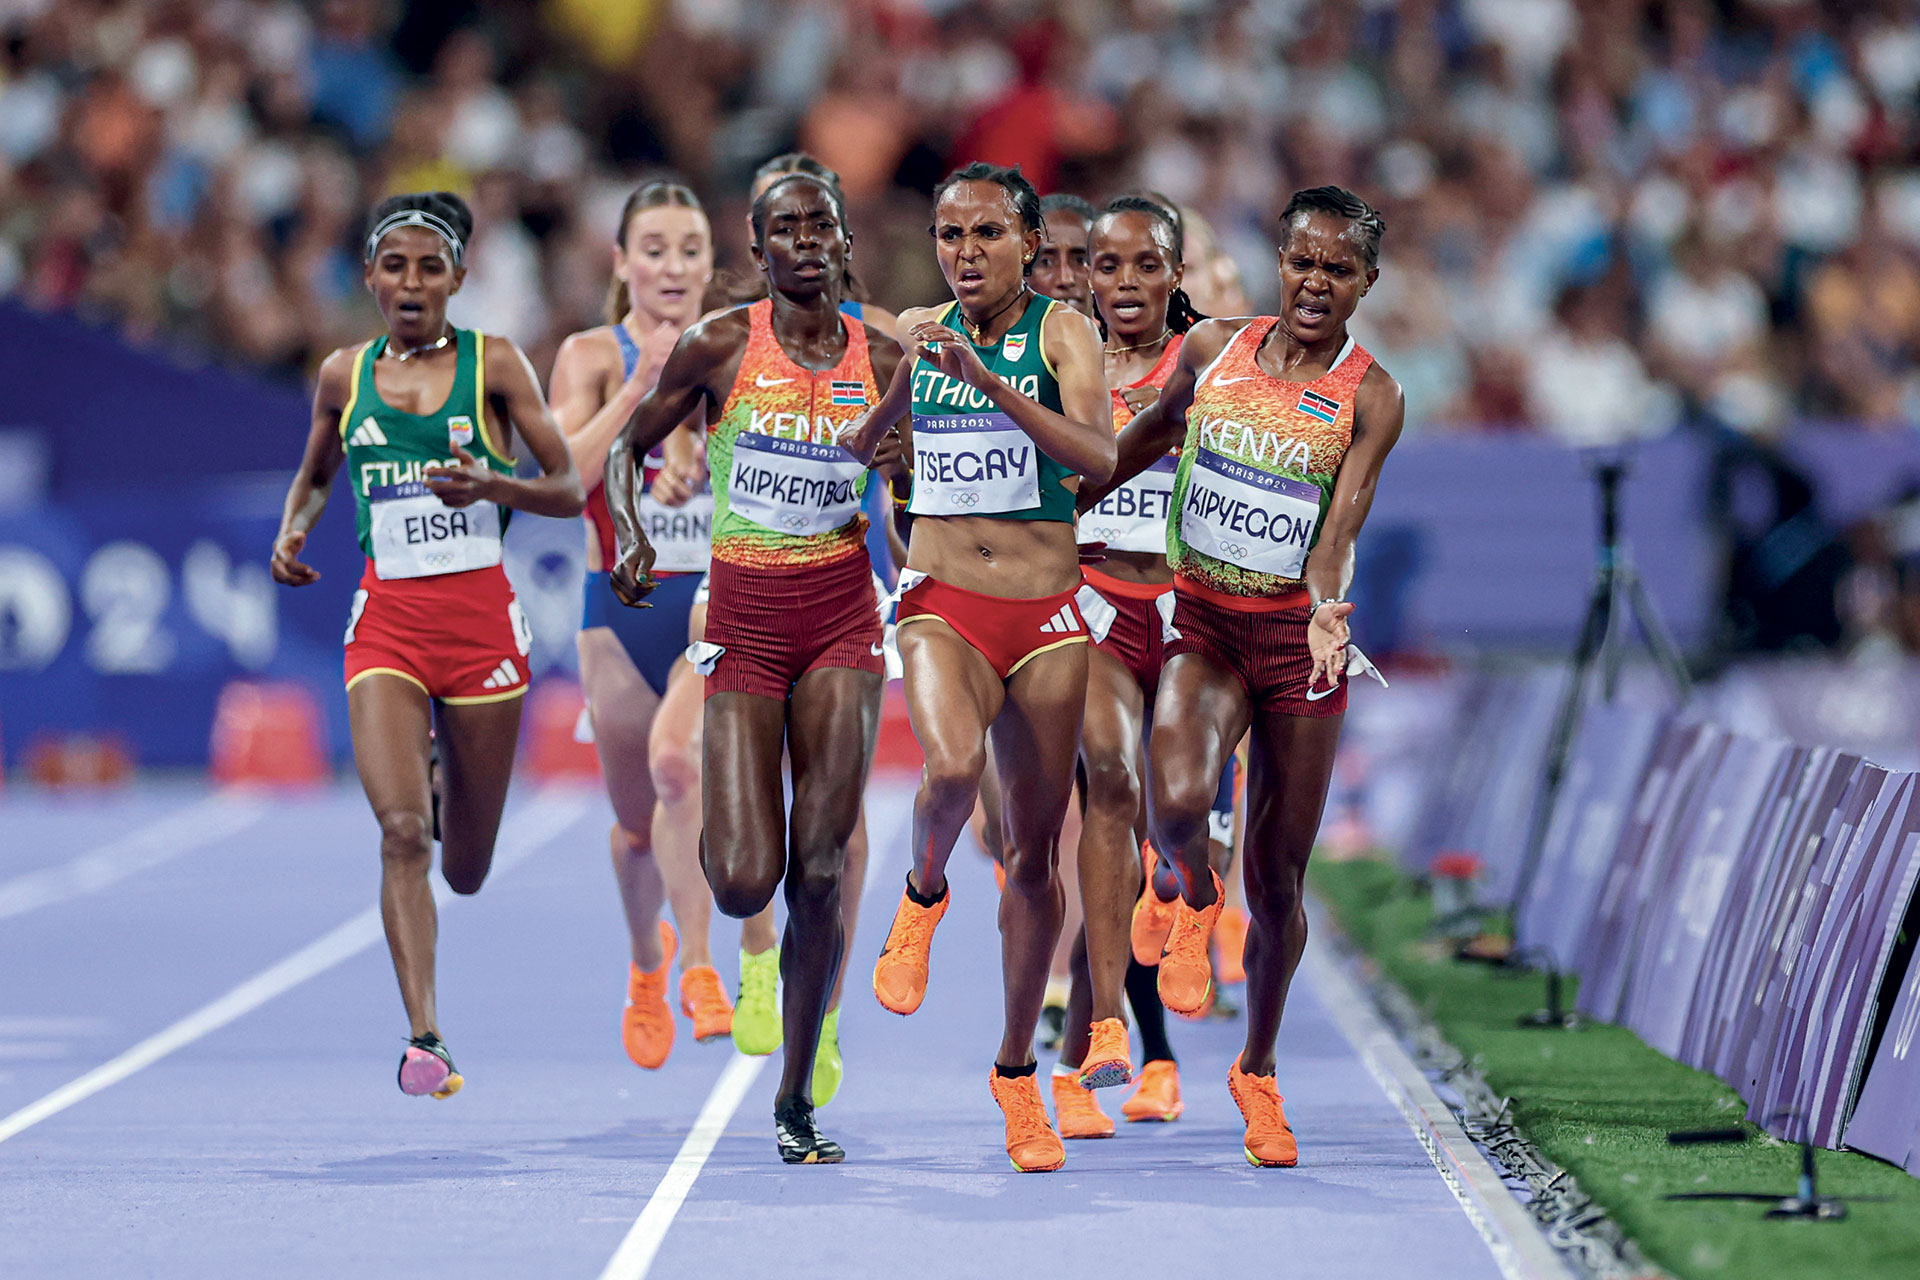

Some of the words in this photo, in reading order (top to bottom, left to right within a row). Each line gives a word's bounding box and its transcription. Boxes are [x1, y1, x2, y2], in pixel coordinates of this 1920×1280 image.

[749, 409, 850, 447] KENY
[926, 420, 957, 429] PARIS
[961, 418, 992, 428] 2024
[771, 440, 808, 455] PARIS
[811, 447, 842, 458] 2024
[1200, 415, 1311, 475] KENYA
[917, 446, 1029, 483] TSEGAY
[1221, 462, 1255, 480] PARIS
[1257, 475, 1287, 491] 2024
[1091, 487, 1172, 519] EBET
[1186, 482, 1312, 548] KIPYEGON
[405, 511, 469, 545] EISA
[641, 512, 713, 541] RAN
